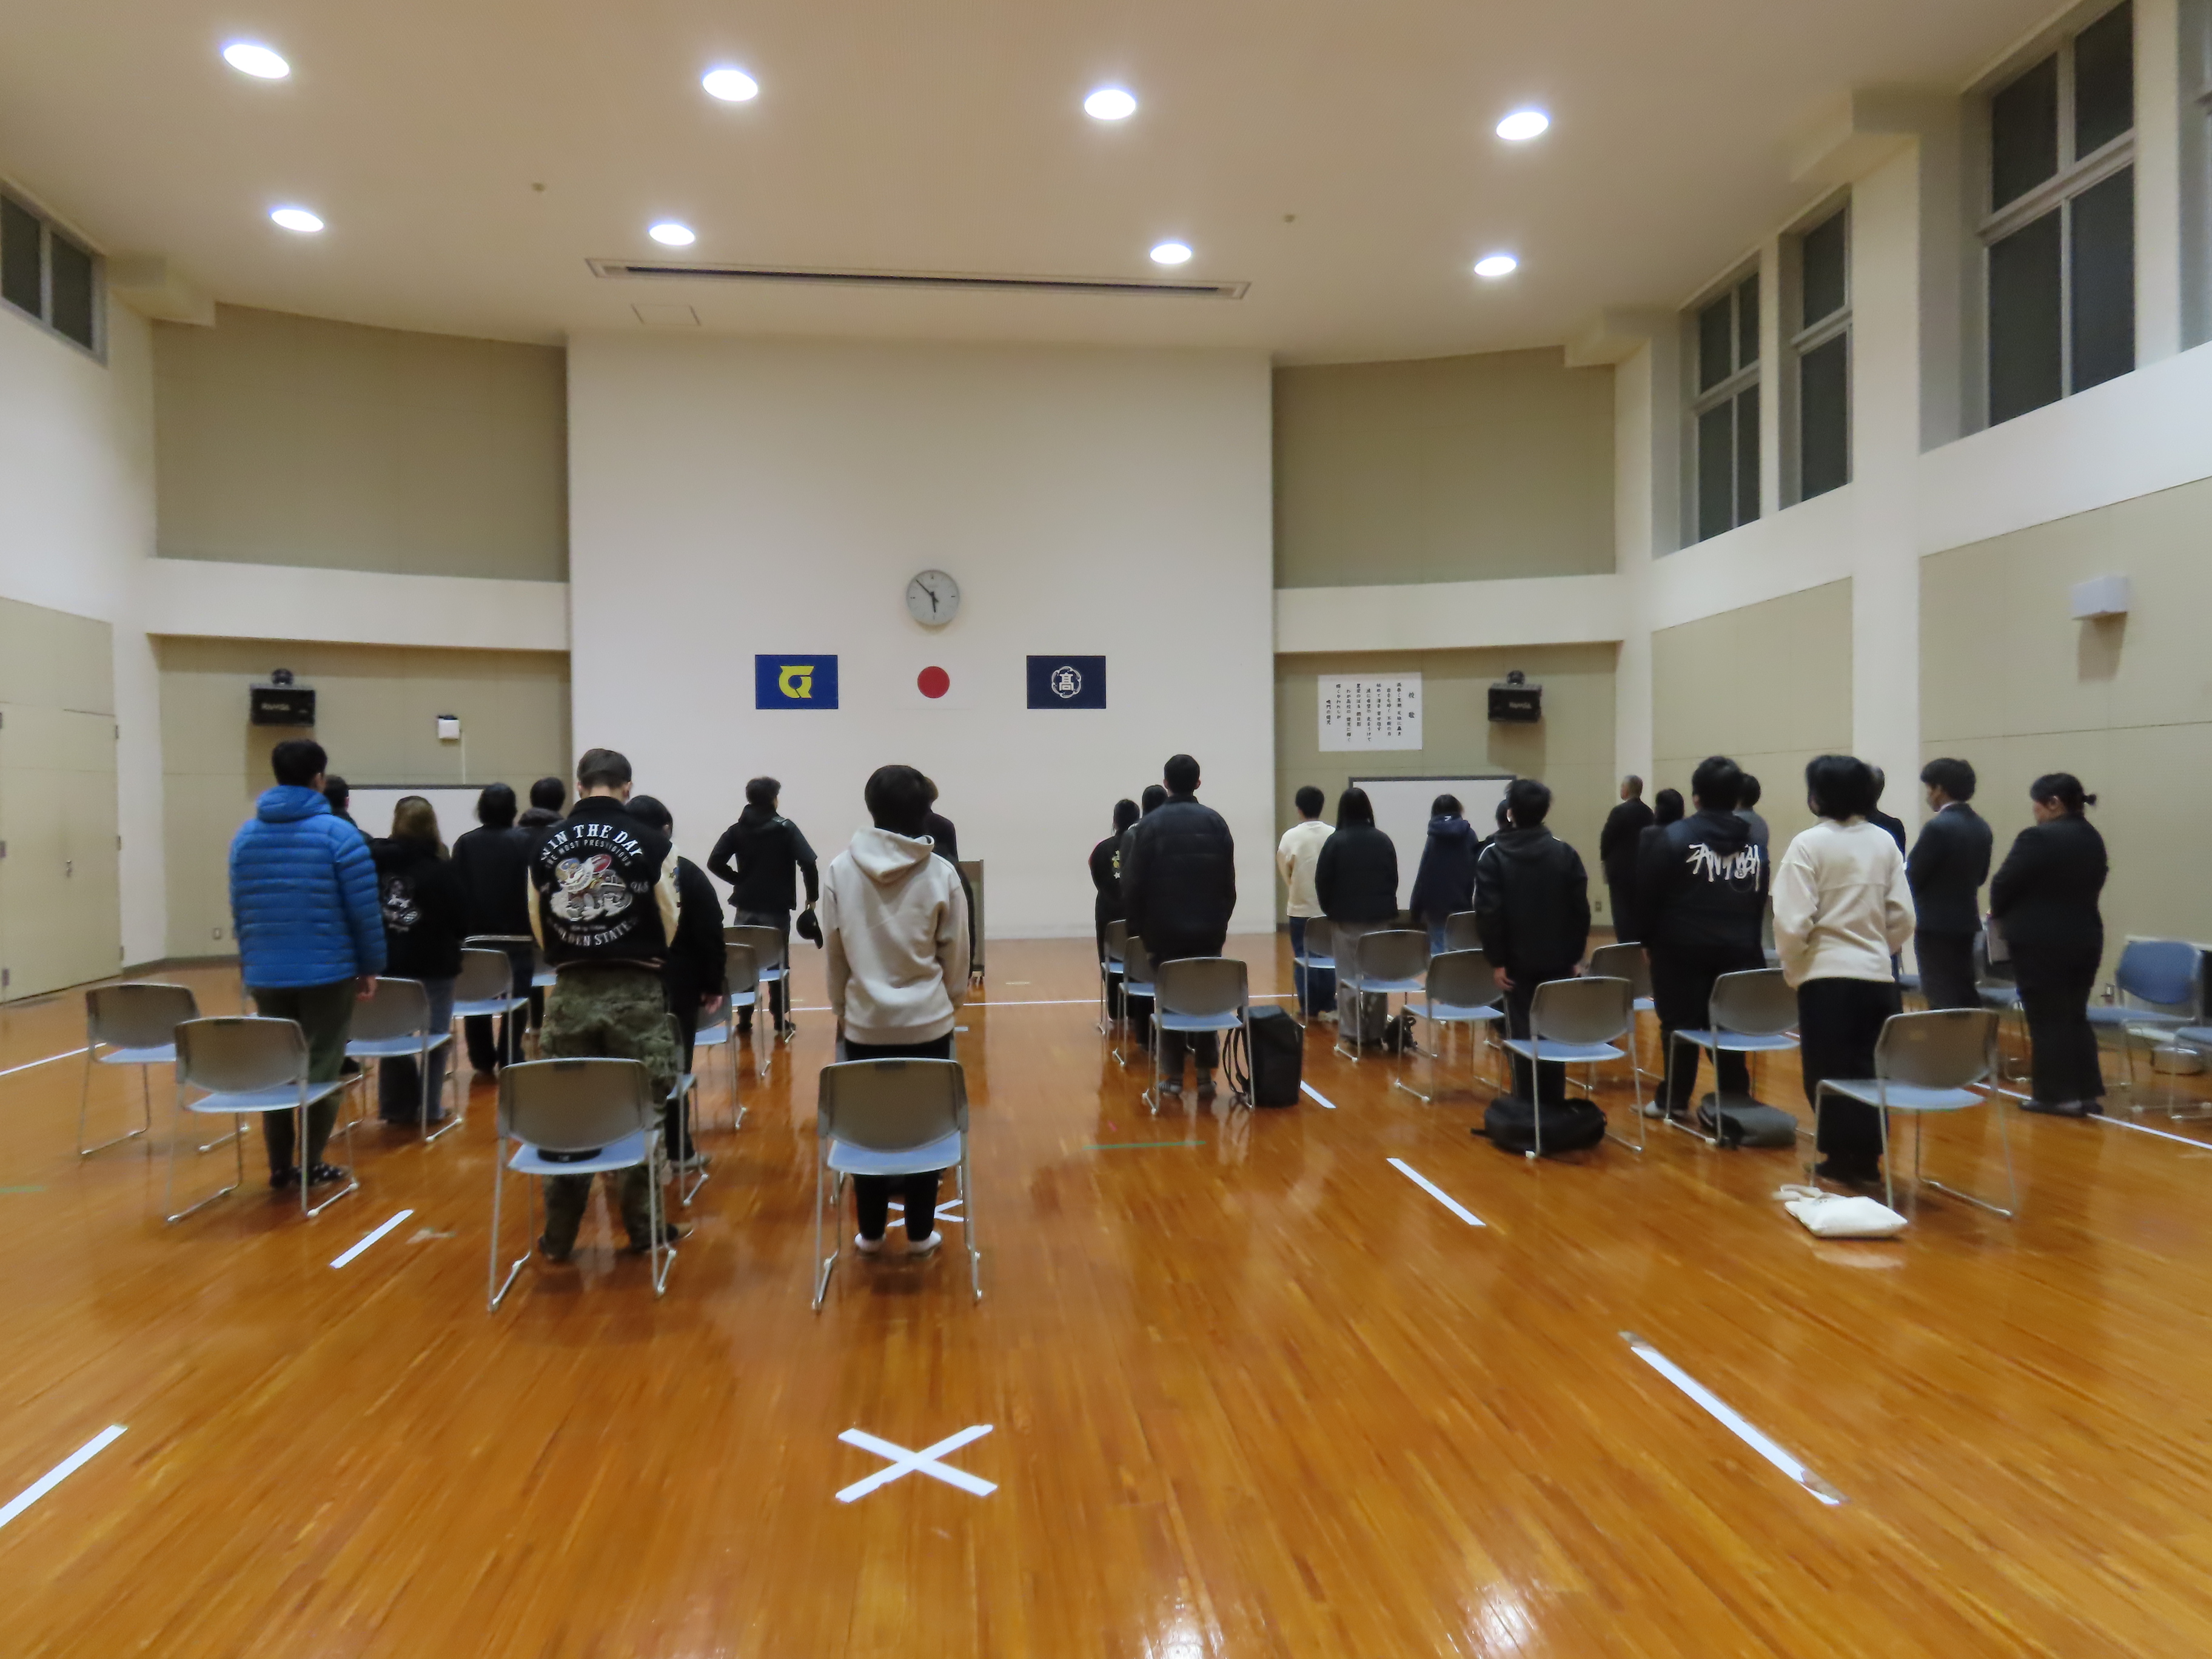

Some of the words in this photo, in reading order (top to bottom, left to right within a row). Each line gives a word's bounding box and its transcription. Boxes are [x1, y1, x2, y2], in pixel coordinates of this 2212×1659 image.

[558, 840, 579, 855] MOST
[573, 823, 613, 839] THE
[612, 830, 644, 857] DAY
